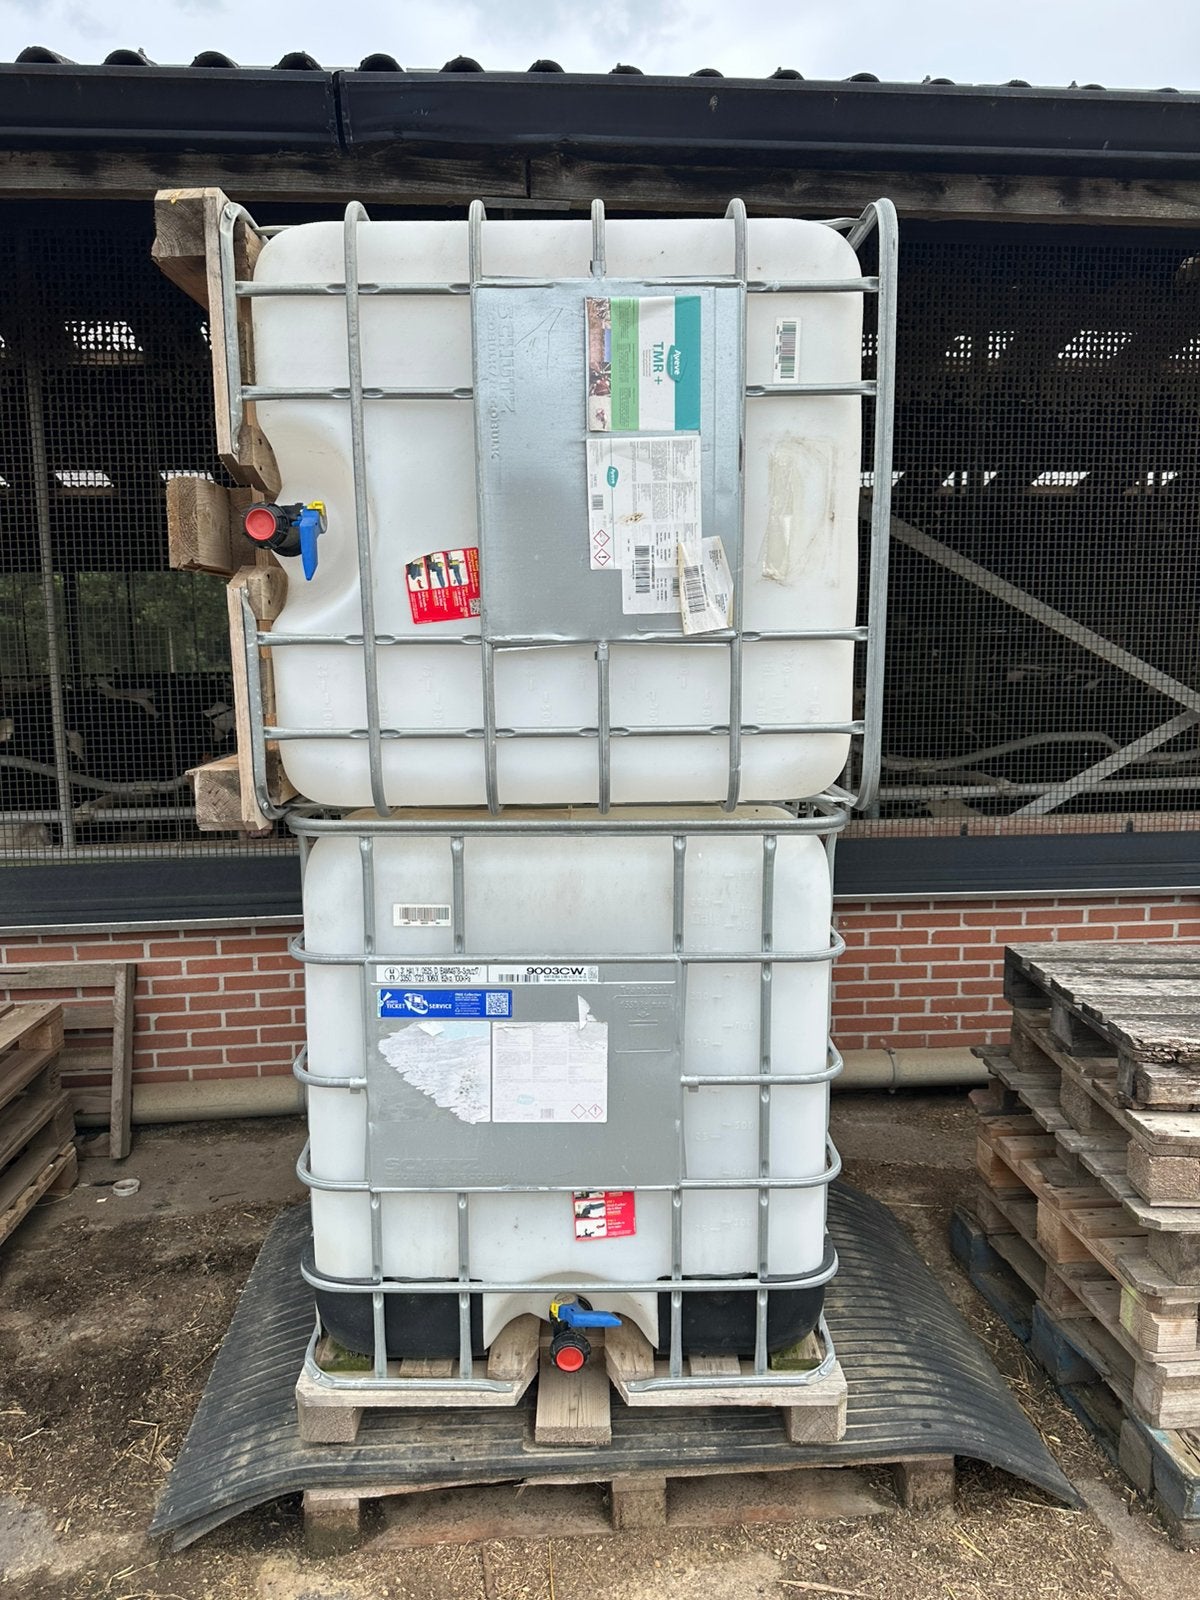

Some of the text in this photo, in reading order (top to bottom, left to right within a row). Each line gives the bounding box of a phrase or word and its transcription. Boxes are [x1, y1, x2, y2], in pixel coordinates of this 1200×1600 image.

[652, 341, 665, 373] TMR
[672, 349, 682, 376] Aveve
[526, 966, 585, 976] 9003CW
